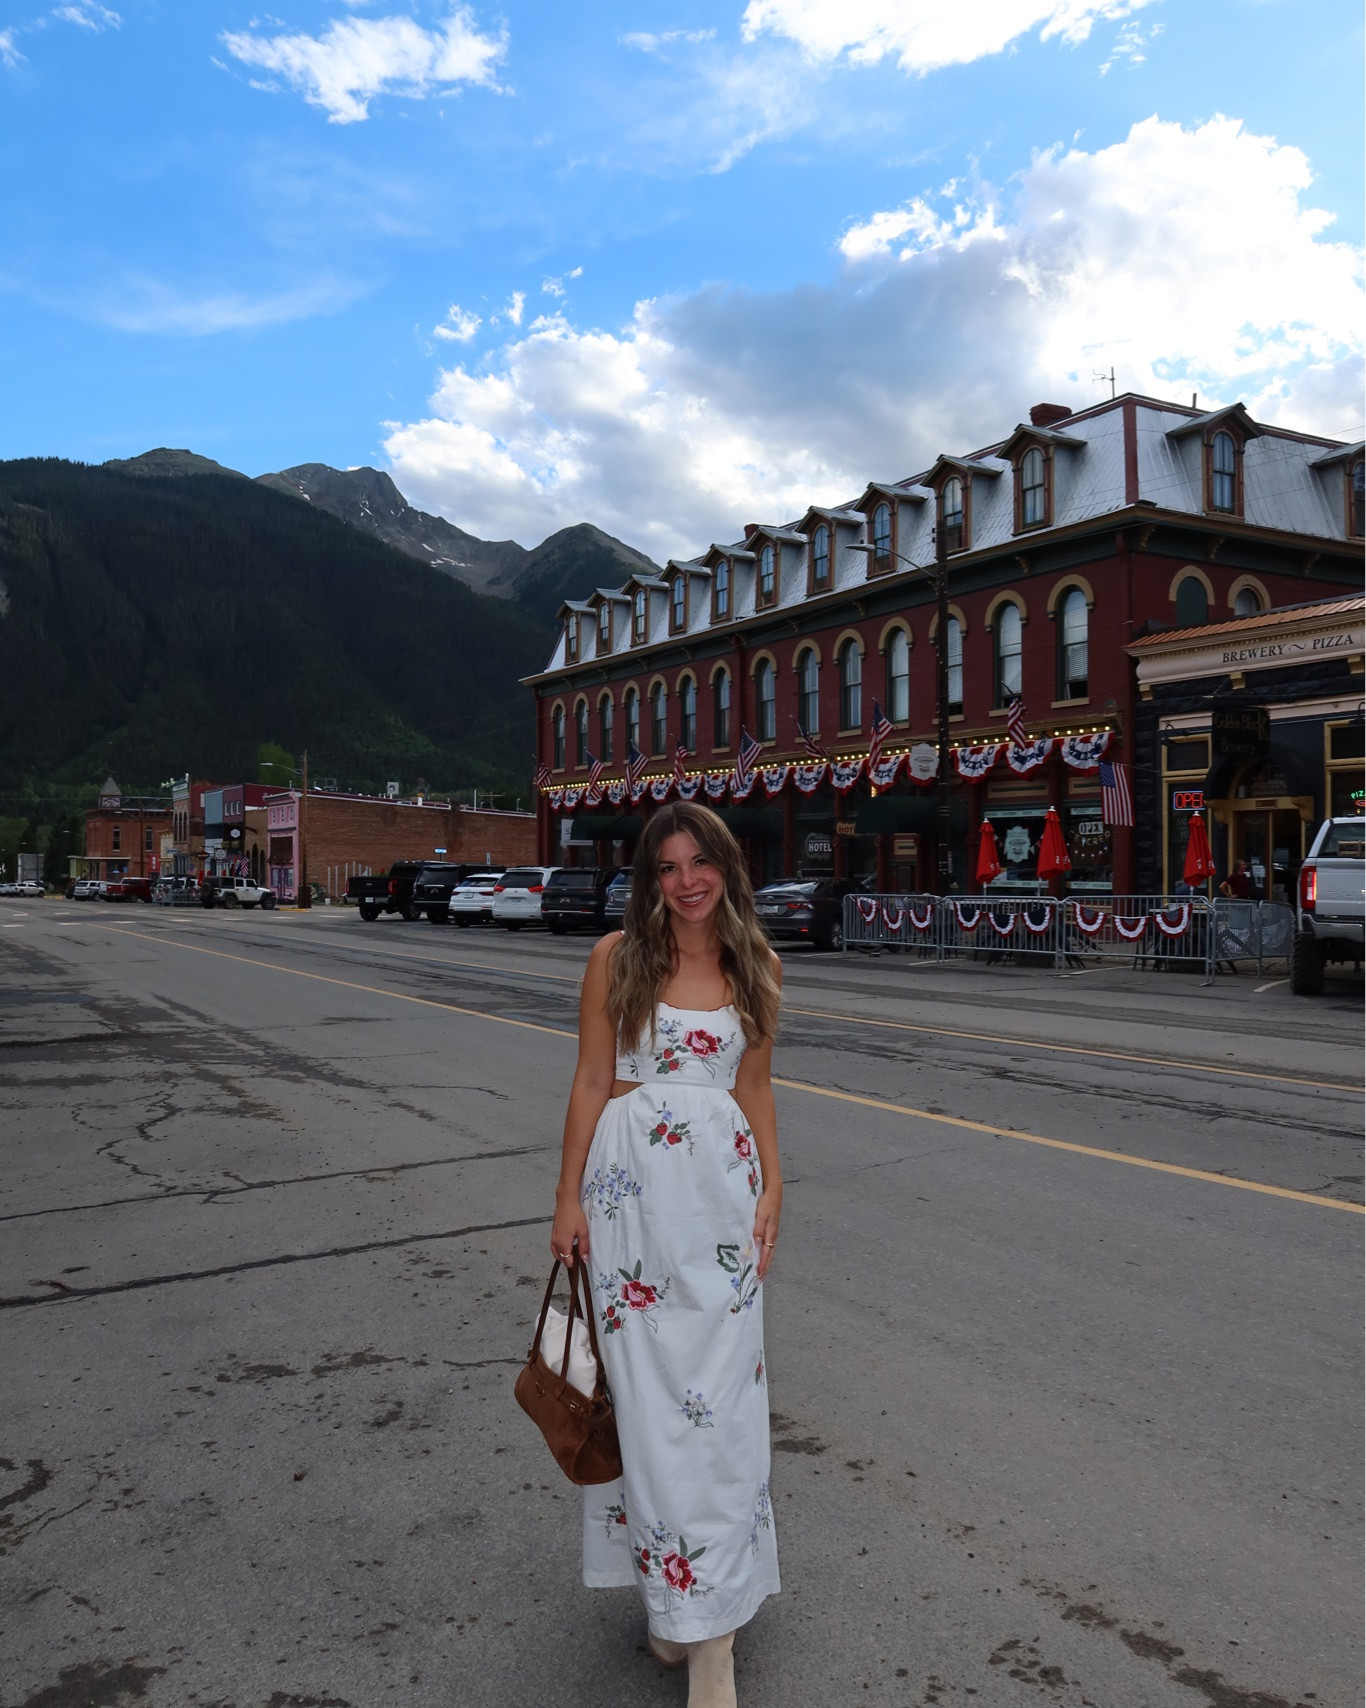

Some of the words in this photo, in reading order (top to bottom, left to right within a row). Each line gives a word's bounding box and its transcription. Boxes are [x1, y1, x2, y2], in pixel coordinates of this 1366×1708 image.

[1222, 644, 1286, 663] BREWERY
[1312, 634, 1354, 650] PIZZA
[808, 843, 833, 852] HOTEL
